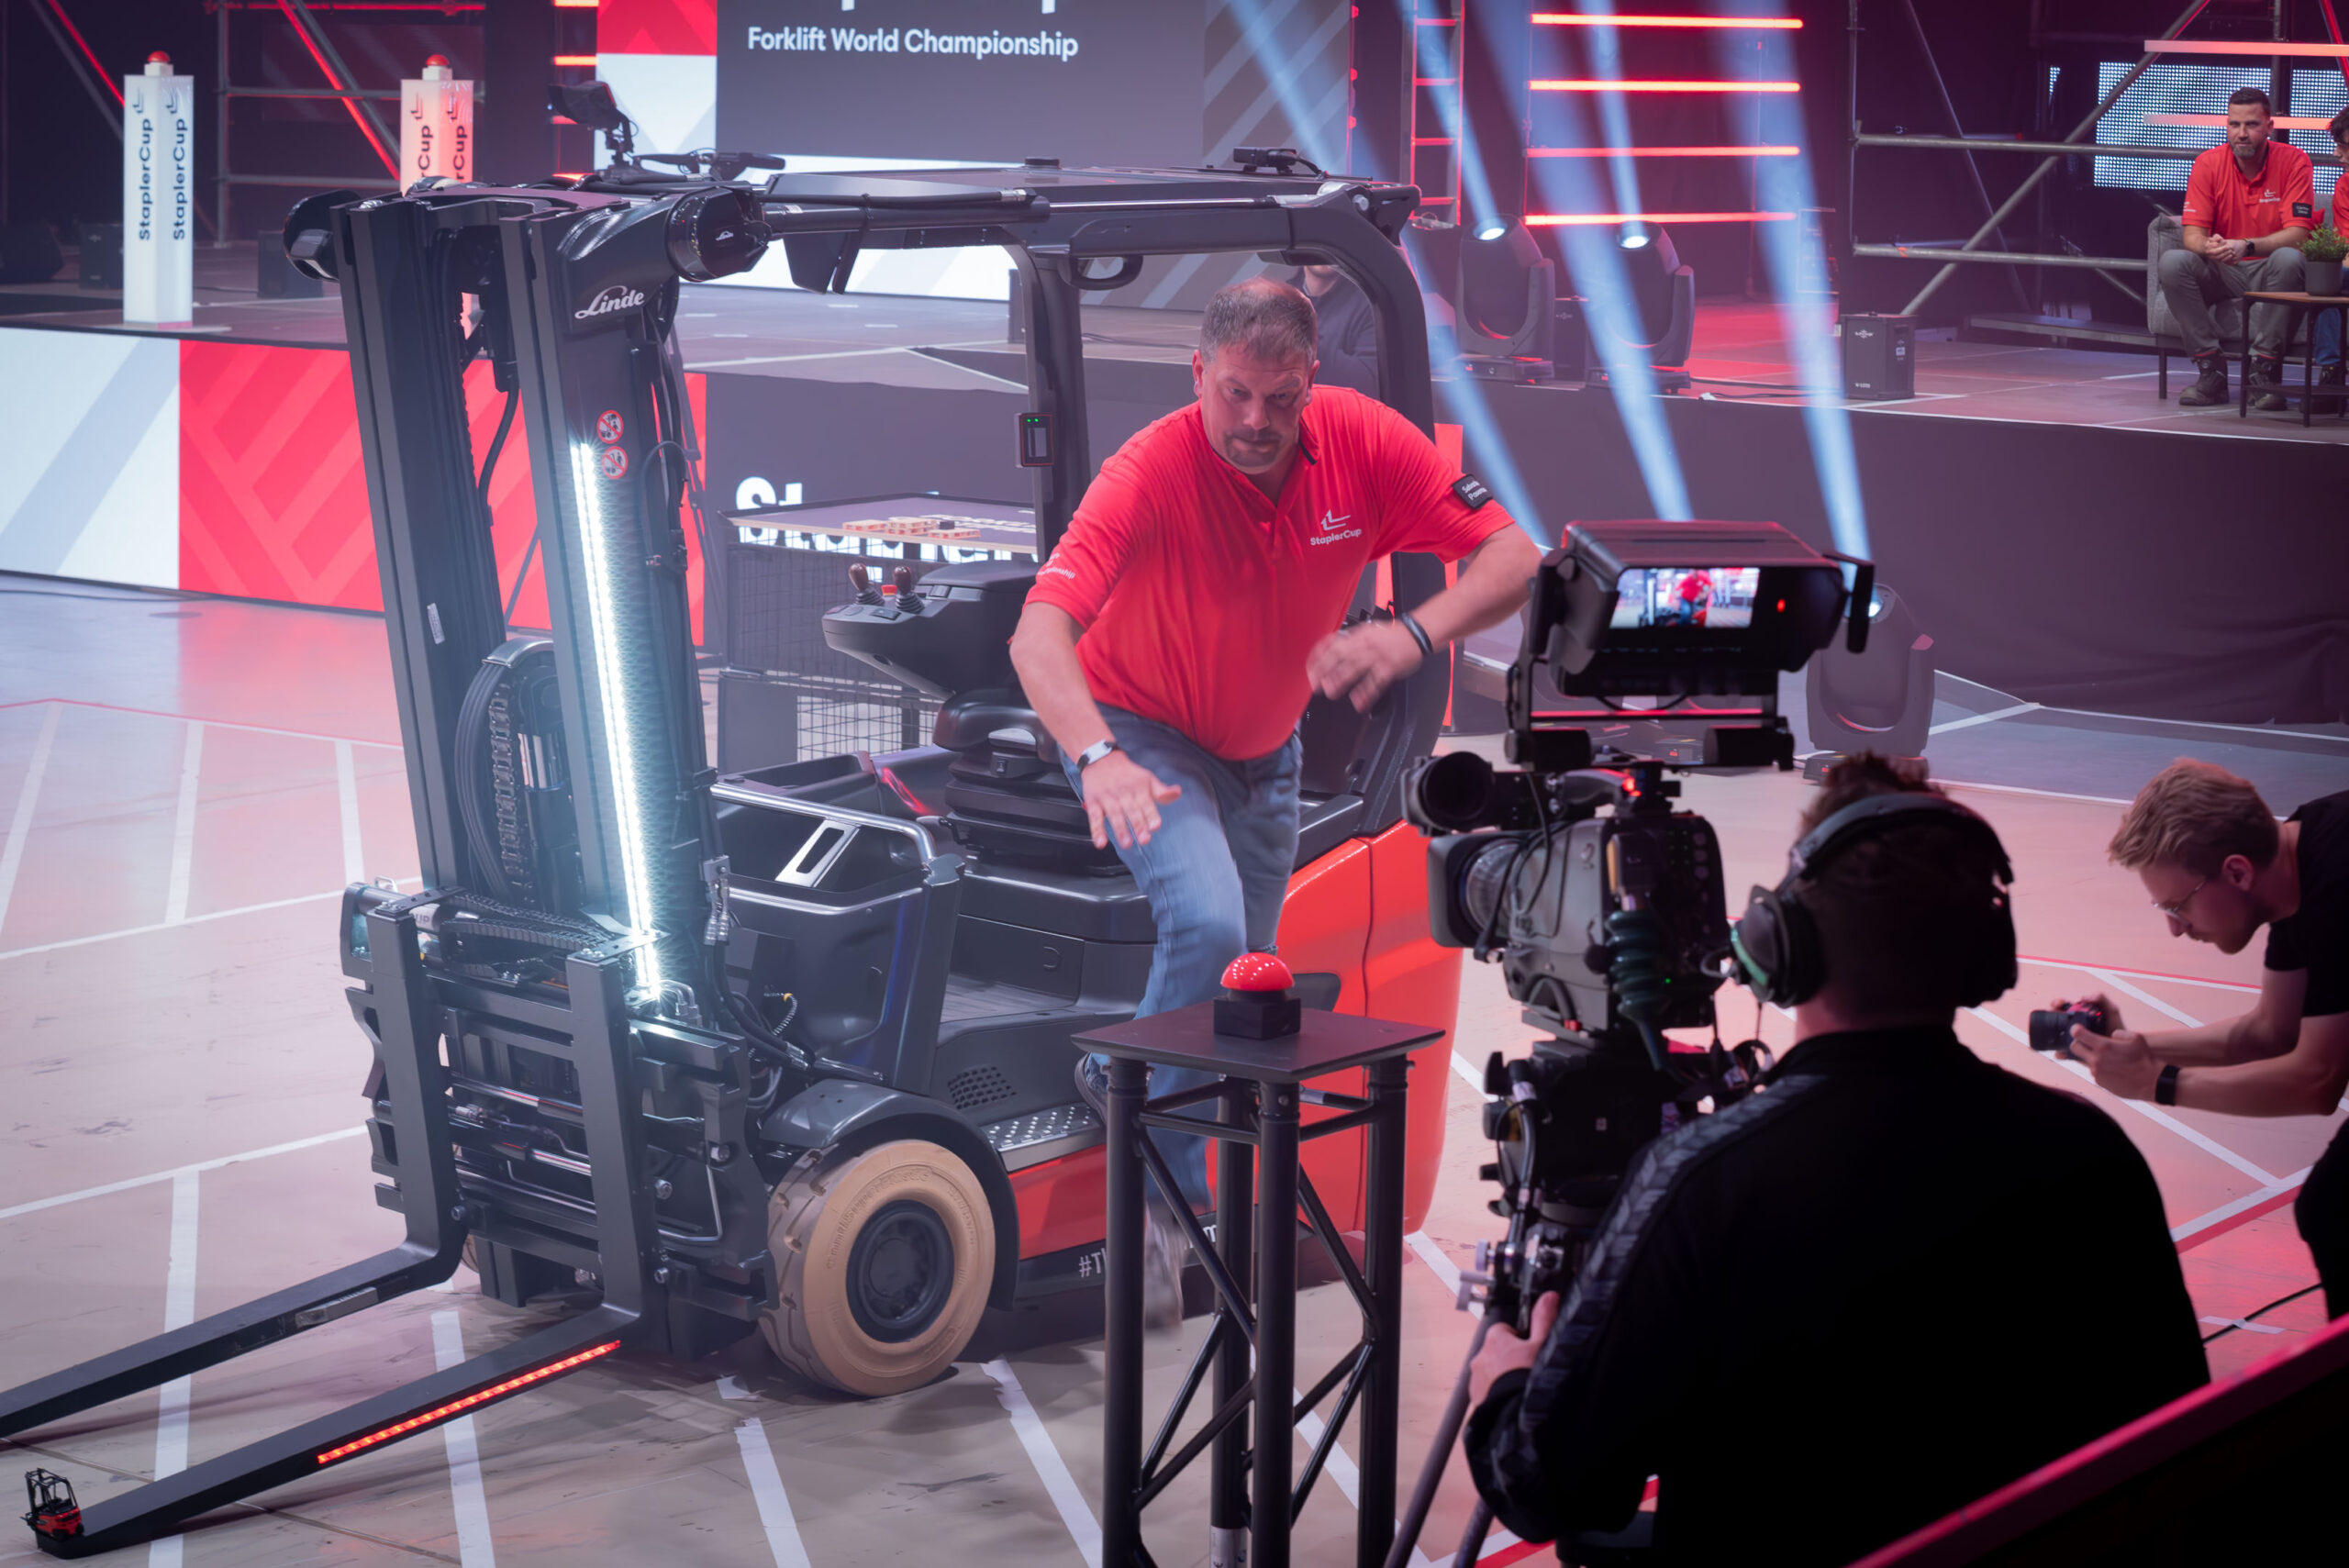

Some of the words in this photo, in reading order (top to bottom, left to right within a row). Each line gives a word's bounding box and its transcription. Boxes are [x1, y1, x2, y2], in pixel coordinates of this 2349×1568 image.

[747, 27, 827, 50] Forklift
[830, 28, 900, 52] World
[904, 29, 1079, 61] Championship
[139, 118, 153, 240] StaplerCup
[173, 118, 188, 240] StaplerCup
[574, 284, 645, 319] Linde
[1309, 528, 1363, 546] StaplerCup
